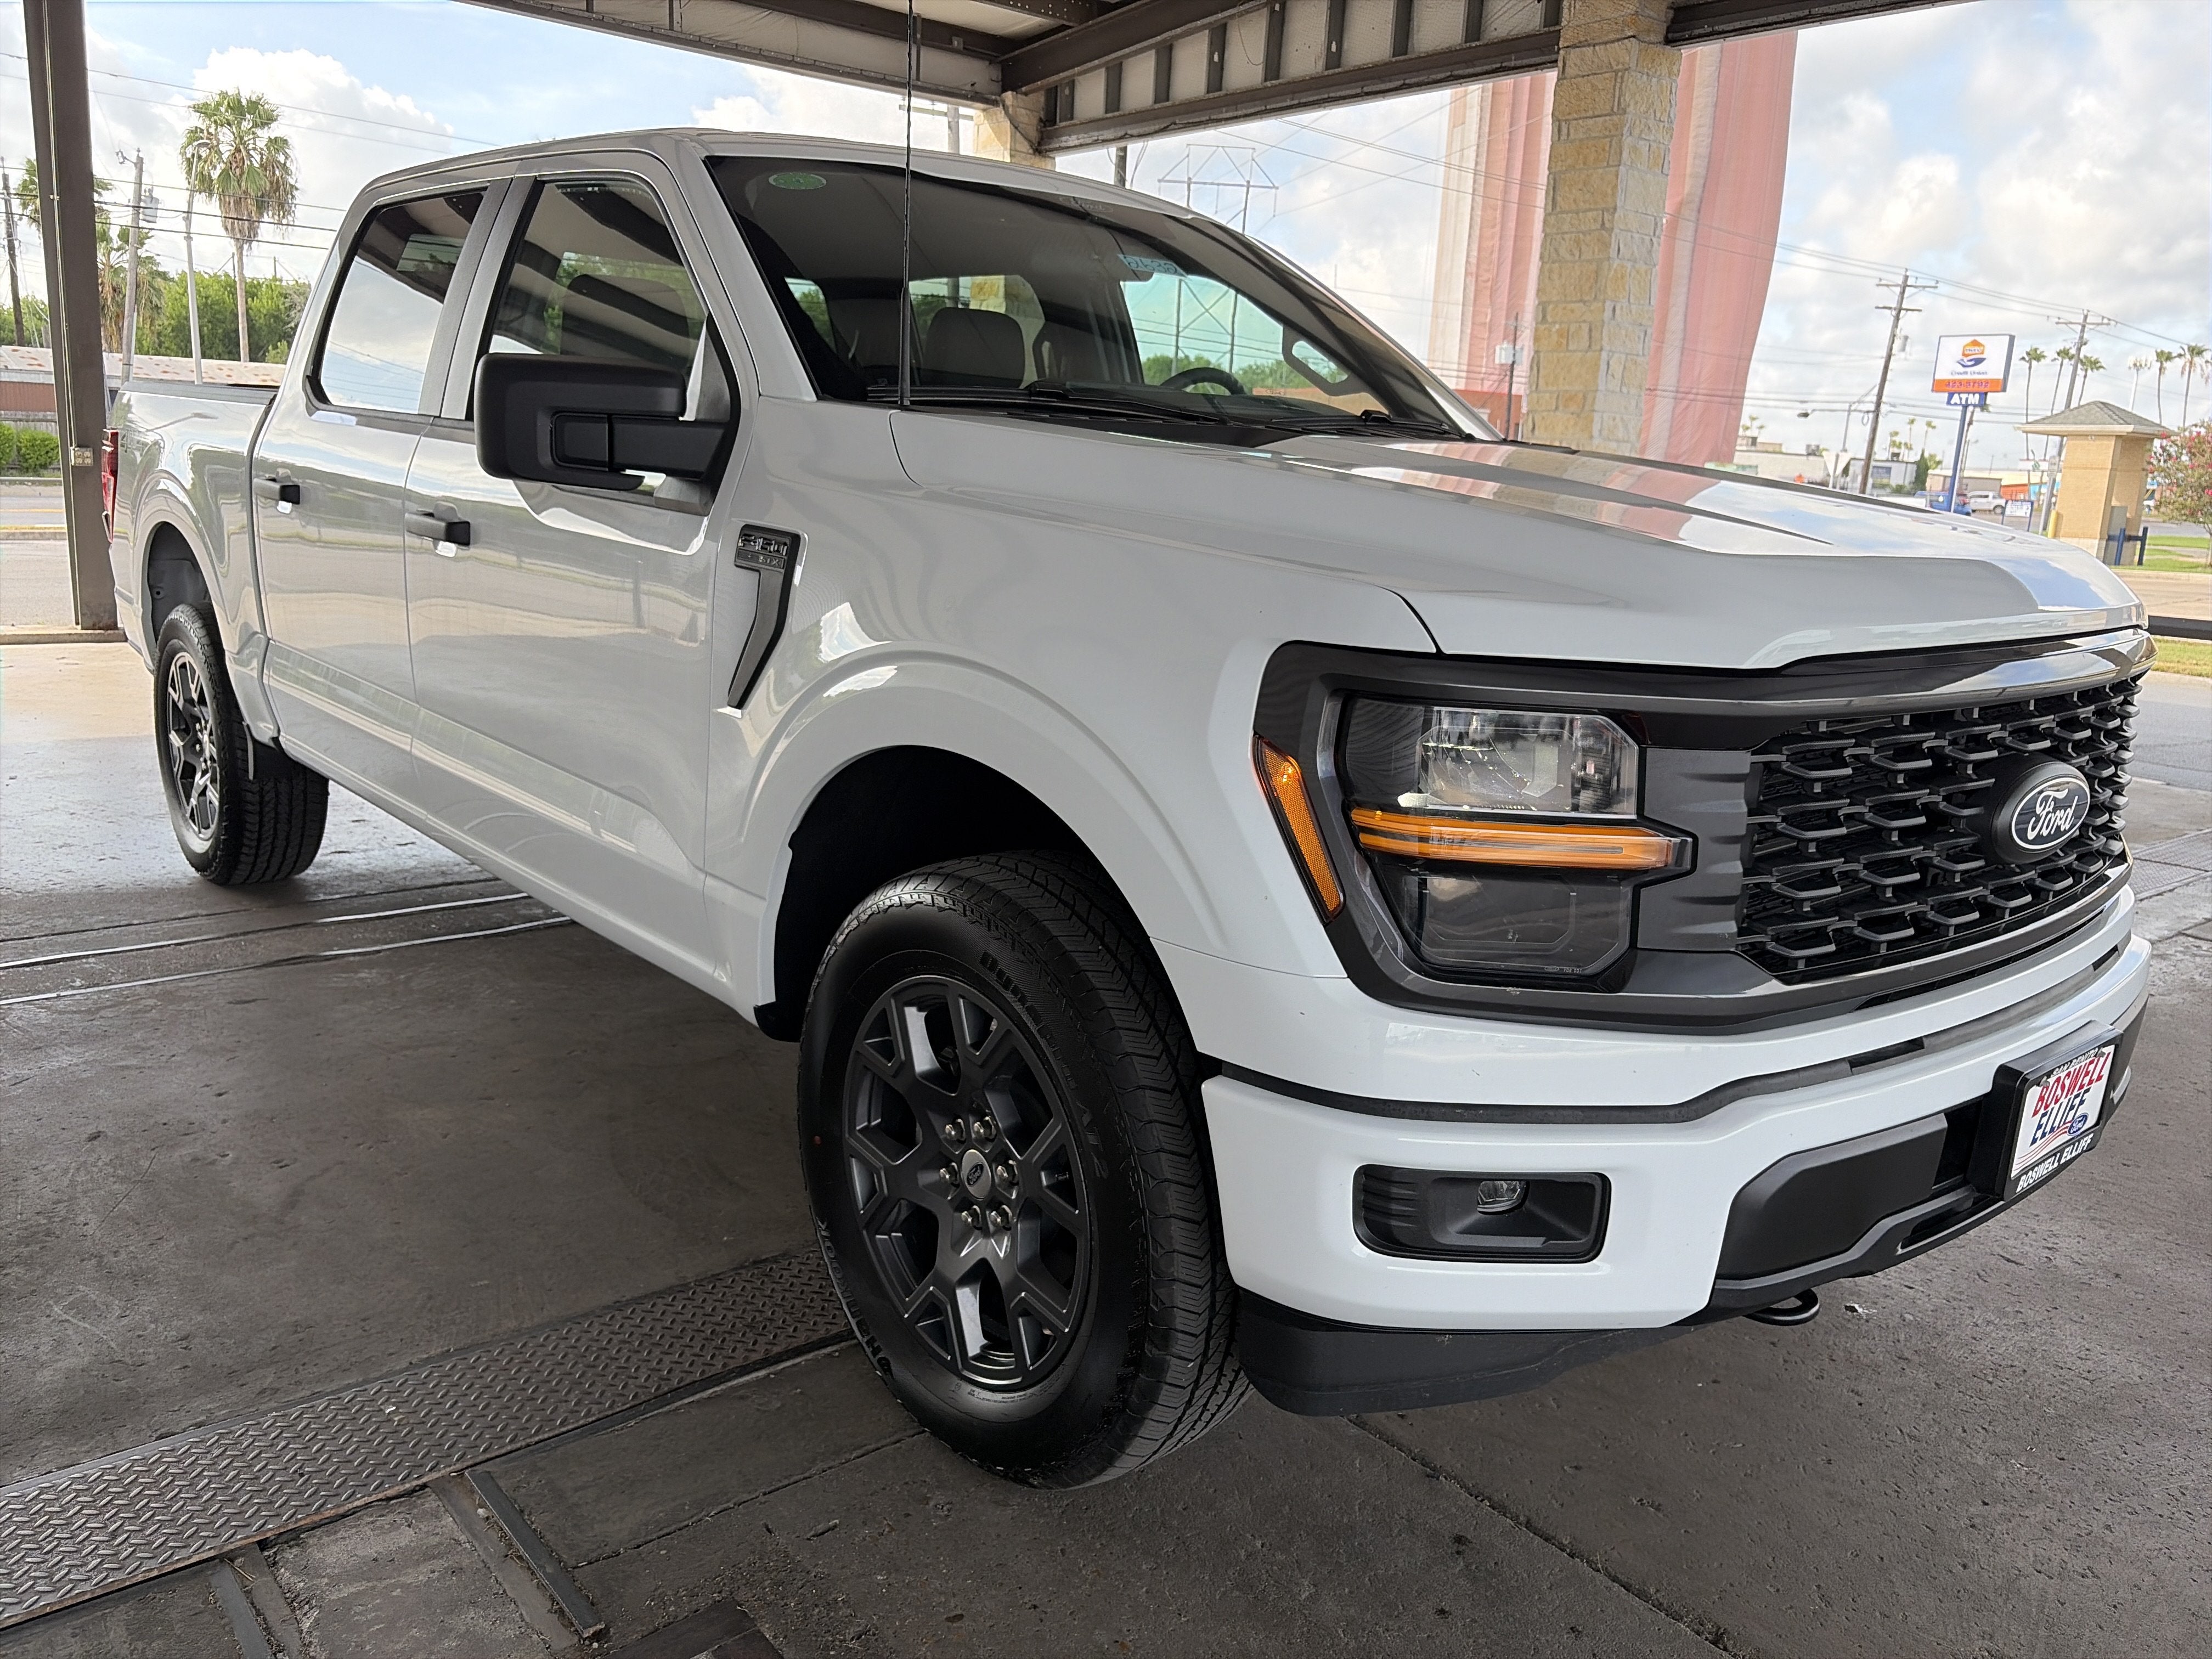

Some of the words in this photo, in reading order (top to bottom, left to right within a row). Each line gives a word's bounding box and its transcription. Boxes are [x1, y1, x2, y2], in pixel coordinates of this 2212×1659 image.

[1950, 393, 1979, 404] ATM
[2027, 788, 2078, 840] Ford
[2032, 1052, 2112, 1118] BOSWELL
[2029, 1086, 2091, 1147] ELLIFF
[2016, 1152, 2061, 1193] BOSWELL
[2060, 1133, 2094, 1166] ELLIFF
